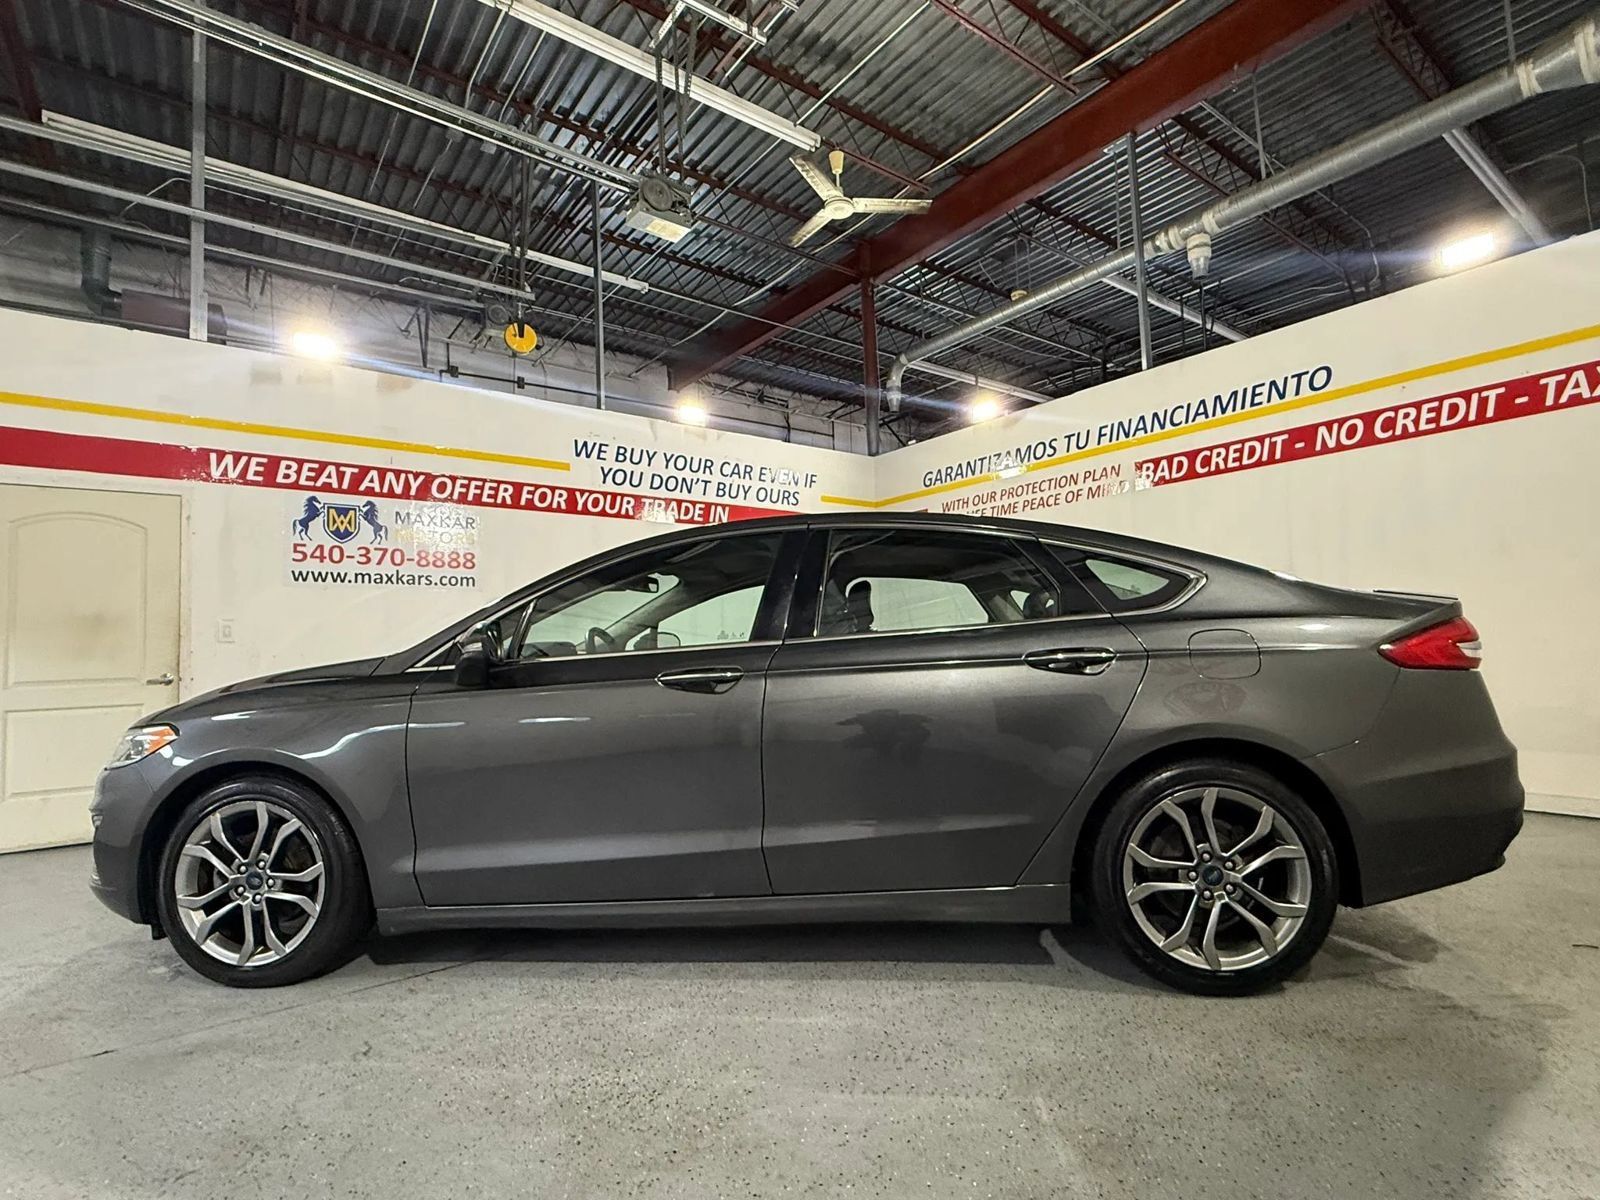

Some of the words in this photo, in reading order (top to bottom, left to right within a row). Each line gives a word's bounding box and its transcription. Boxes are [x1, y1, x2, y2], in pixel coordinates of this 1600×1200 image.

[923, 439, 1057, 488] GARANTIZAMOS
[1063, 430, 1091, 452] TU
[1097, 365, 1333, 446] FINANCIAMIENTO
[1141, 455, 1189, 483] BAD
[1195, 433, 1289, 471] CREDIT
[1315, 418, 1364, 451] NO
[1373, 387, 1505, 439] CREDIT
[574, 439, 608, 461] WE
[615, 445, 657, 468] BUY
[663, 453, 714, 475] YOUR
[720, 461, 753, 481] CAR
[759, 467, 799, 486] EVEN
[804, 473, 817, 488] IF
[209, 452, 268, 481] WE
[276, 459, 359, 490] BEAT
[359, 472, 425, 497] ANY
[431, 476, 512, 505] OFFER
[520, 486, 567, 510] FOR
[574, 491, 634, 516] YOUR
[641, 498, 706, 522] TRADE
[709, 505, 730, 523] IN
[600, 466, 641, 488] YOU
[650, 472, 712, 497] DON'T
[716, 481, 752, 501] BUY
[756, 487, 800, 506] OURS
[942, 497, 969, 512] WITH
[972, 491, 997, 506] OUR
[1000, 472, 1079, 500] PROTECTION
[1083, 464, 1121, 484] PLAN
[990, 501, 1019, 517] TIME
[1022, 495, 1061, 512] PEACE
[1065, 489, 1083, 504] OF
[395, 511, 476, 529] MAXKAR
[291, 542, 477, 570] 540-370-8888
[291, 569, 476, 588] www.maxkars.com
